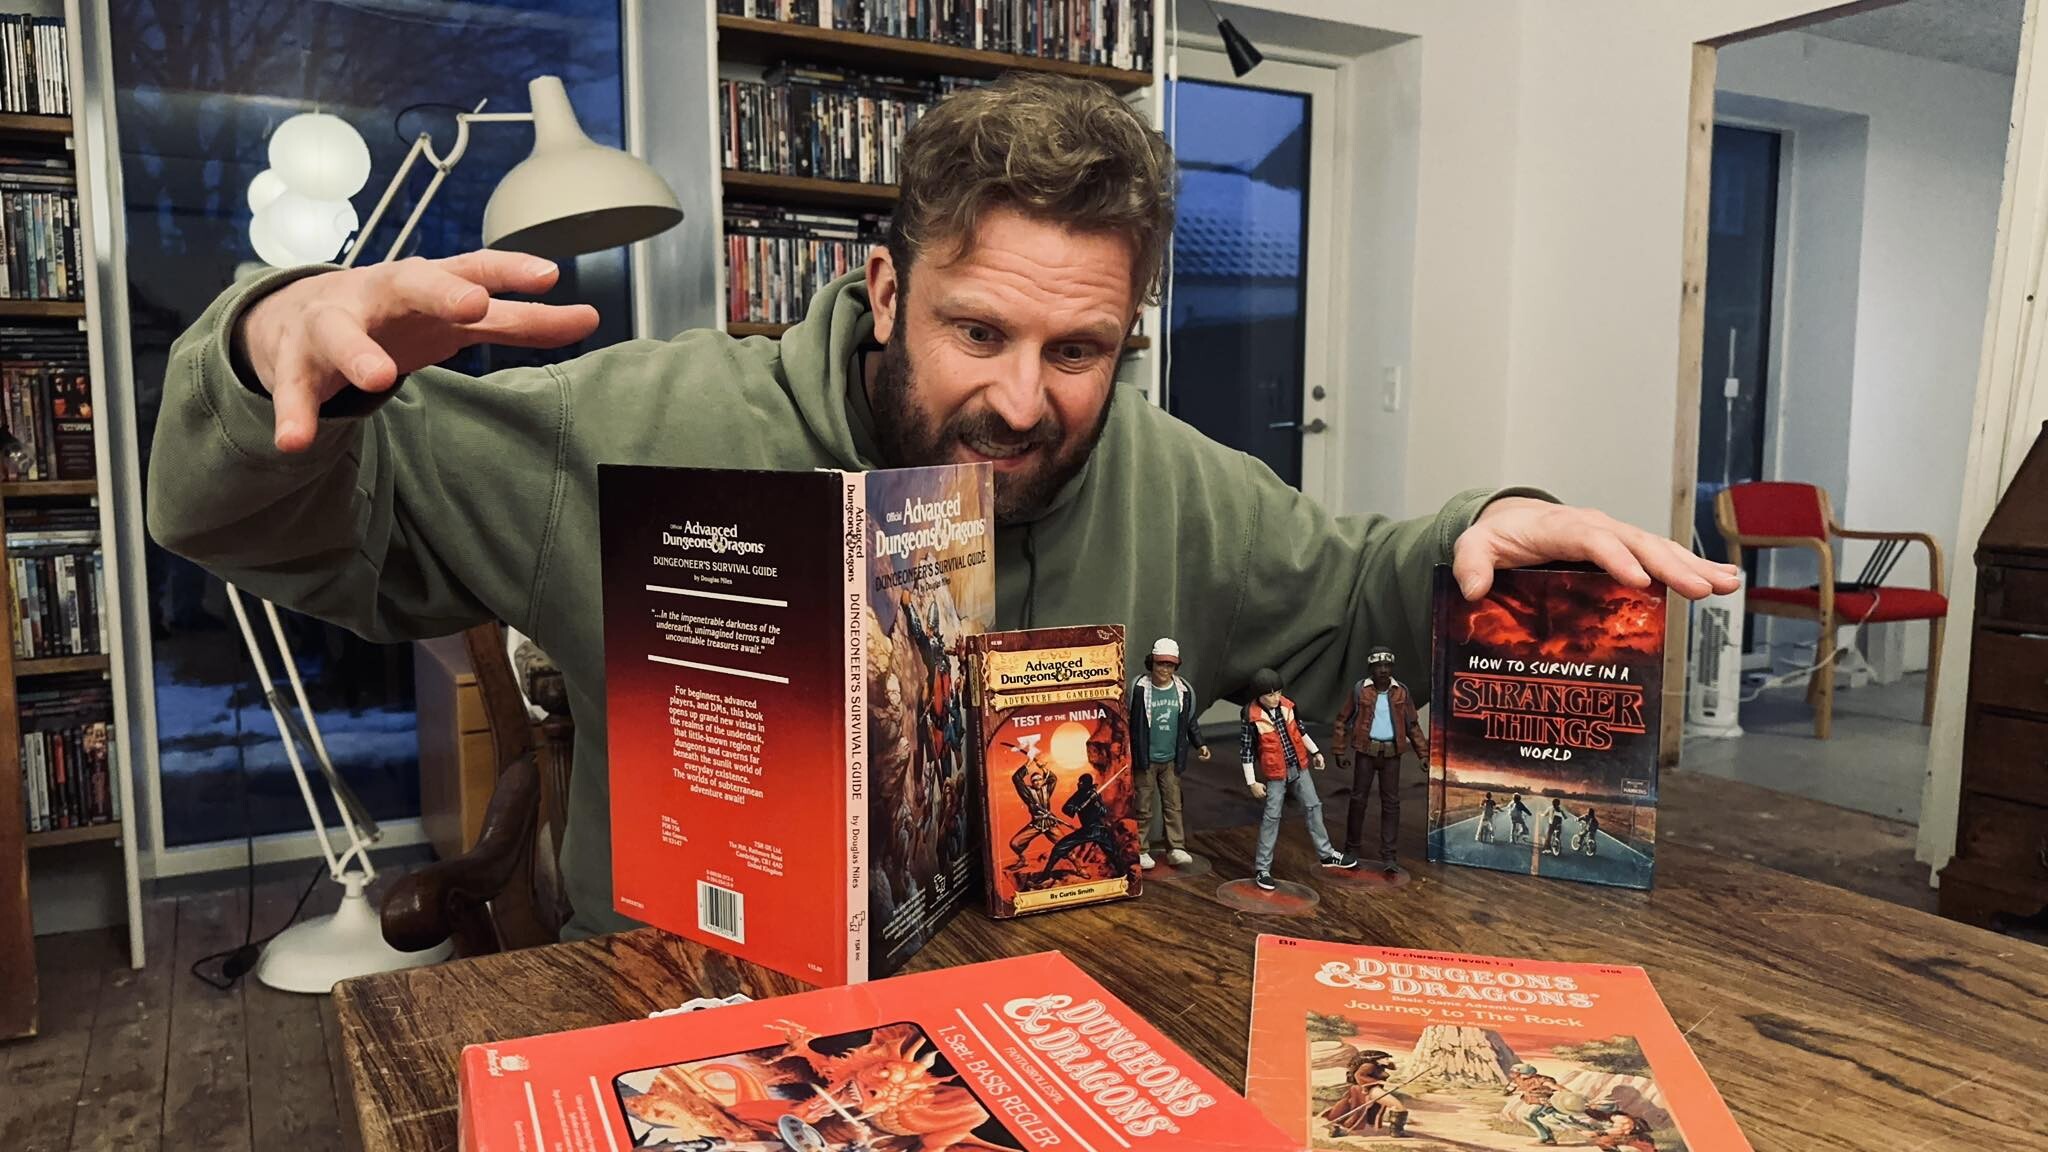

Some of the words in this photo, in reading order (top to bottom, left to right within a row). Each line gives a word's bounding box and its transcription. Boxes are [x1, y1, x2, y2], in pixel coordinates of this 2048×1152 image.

[903, 492, 960, 525] Advanced
[684, 520, 738, 538] Advanced
[856, 507, 864, 558] Advanced
[653, 556, 711, 571] DUNGEONEER'S
[712, 561, 751, 575] SURVIVAL
[752, 565, 778, 577] GUIDE
[693, 574, 700, 582] by
[701, 575, 719, 584] Douglas
[875, 563, 933, 591] DUNGEONEER'S
[935, 555, 966, 576] SURVIVAL
[967, 550, 986, 566] GUIDE
[656, 621, 693, 634] underearth,
[694, 626, 734, 639] unimagined
[735, 632, 760, 643] terrors
[761, 636, 775, 645] and
[669, 611, 679, 620] the
[681, 612, 724, 627] impenetrable
[725, 619, 758, 632] darkness
[759, 623, 768, 633] of
[768, 624, 780, 634] the
[665, 633, 705, 646] uncountable
[707, 638, 739, 651] treasures
[850, 593, 861, 693] DUNGEONEER'S
[1025, 657, 1083, 672] Advanced
[1469, 655, 1502, 670] HOW
[1507, 659, 1525, 672] TO
[1529, 661, 1596, 677] SURVIVE
[1598, 665, 1616, 680] IN
[1620, 666, 1630, 682] A
[670, 696, 695, 709] players,
[697, 702, 709, 710] and
[710, 703, 729, 715] DMs,
[731, 707, 744, 718] this
[745, 710, 764, 721] book
[675, 685, 686, 695] For
[688, 688, 723, 703] beginners,
[724, 696, 757, 709] advanced
[1004, 693, 1051, 705] ADVENTURE
[1066, 689, 1110, 699] GAMEBOOK
[1453, 677, 1645, 728] STRANGER
[669, 706, 688, 718] opens
[689, 711, 698, 720] up
[699, 713, 719, 723] grand
[720, 717, 733, 725] new
[736, 719, 756, 731] vistas
[758, 722, 765, 732] in
[670, 716, 680, 726] the
[681, 720, 704, 731] realms
[705, 724, 712, 732] of
[714, 725, 725, 735] the
[727, 729, 764, 744] underdark,
[851, 696, 861, 758] SURVIVAL
[1012, 715, 1042, 728] TEST
[1069, 708, 1107, 722] NINJA
[1481, 710, 1613, 750] THINGS
[674, 727, 687, 738] that
[688, 730, 728, 747] little-known
[730, 740, 751, 752] region
[753, 744, 761, 754] of
[675, 738, 706, 752] dungeons
[708, 747, 720, 756] and
[721, 749, 748, 762] caverns
[749, 754, 760, 764] far
[1520, 745, 1572, 762] WORLD
[673, 748, 699, 760] beneath
[700, 754, 711, 764] the
[712, 758, 732, 769] sunlit
[734, 763, 753, 773] world
[754, 767, 762, 776] of
[684, 762, 714, 778] everyday
[715, 769, 750, 784] existence.
[673, 768, 686, 779] The
[686, 772, 708, 785] worlds
[710, 778, 717, 786] of
[718, 781, 764, 798] subterranean
[690, 784, 723, 799] adventure
[852, 761, 861, 800] GUIDE
[851, 815, 860, 825] by
[851, 829, 860, 864] Douglas
[852, 866, 861, 889] Niles
[1403, 952, 1454, 962] character
[1314, 961, 1385, 991] &
[1353, 958, 1578, 991] DUNGEONS
[1388, 977, 1594, 1008] DRAGONS
[1392, 995, 1423, 1003] Basic
[1427, 998, 1461, 1007] Game
[1465, 1002, 1527, 1012] Adventure
[1344, 999, 1433, 1017] Journey
[1441, 1008, 1464, 1018] to
[1470, 1010, 1517, 1022] The
[1524, 1014, 1584, 1027] Rock
[1003, 993, 1073, 1035] &
[1056, 998, 1217, 1117] DUNGEONS
[937, 1025, 958, 1036] 1.
[966, 1059, 1012, 1096] BASIS
[997, 1095, 1061, 1148] REGLER
[1028, 1027, 1174, 1136] DRAGONS
